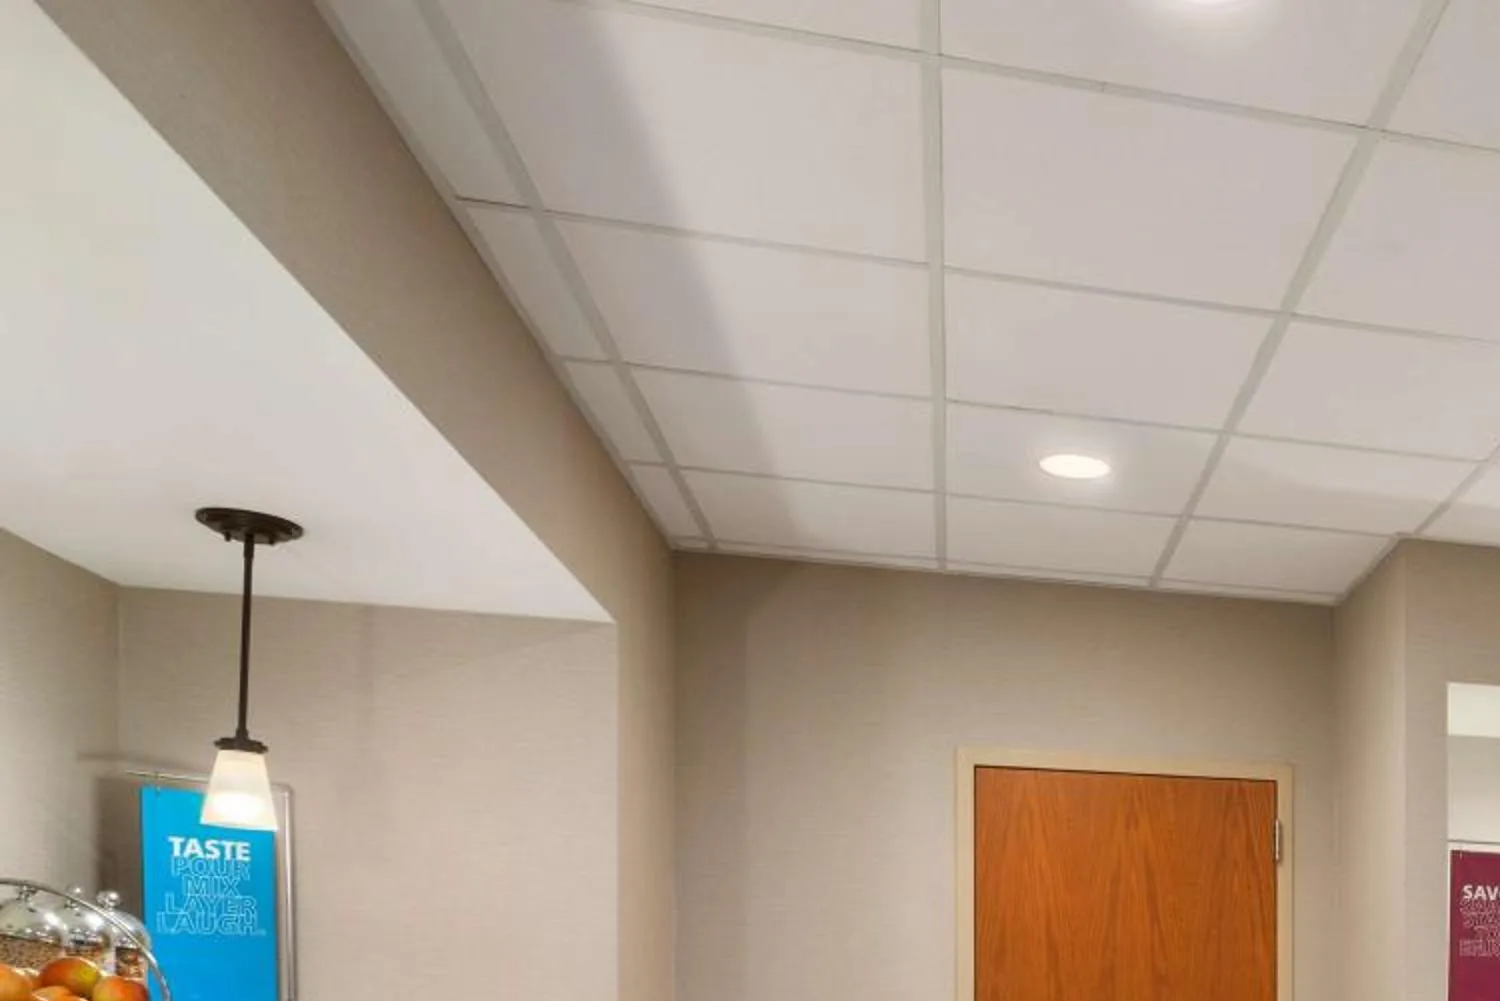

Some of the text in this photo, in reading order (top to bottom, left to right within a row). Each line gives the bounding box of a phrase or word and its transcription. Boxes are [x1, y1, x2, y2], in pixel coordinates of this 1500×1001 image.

[168, 836, 251, 861] TASTE
[171, 857, 251, 881] POUR
[183, 874, 240, 898] MIX
[165, 893, 257, 916] LAYER
